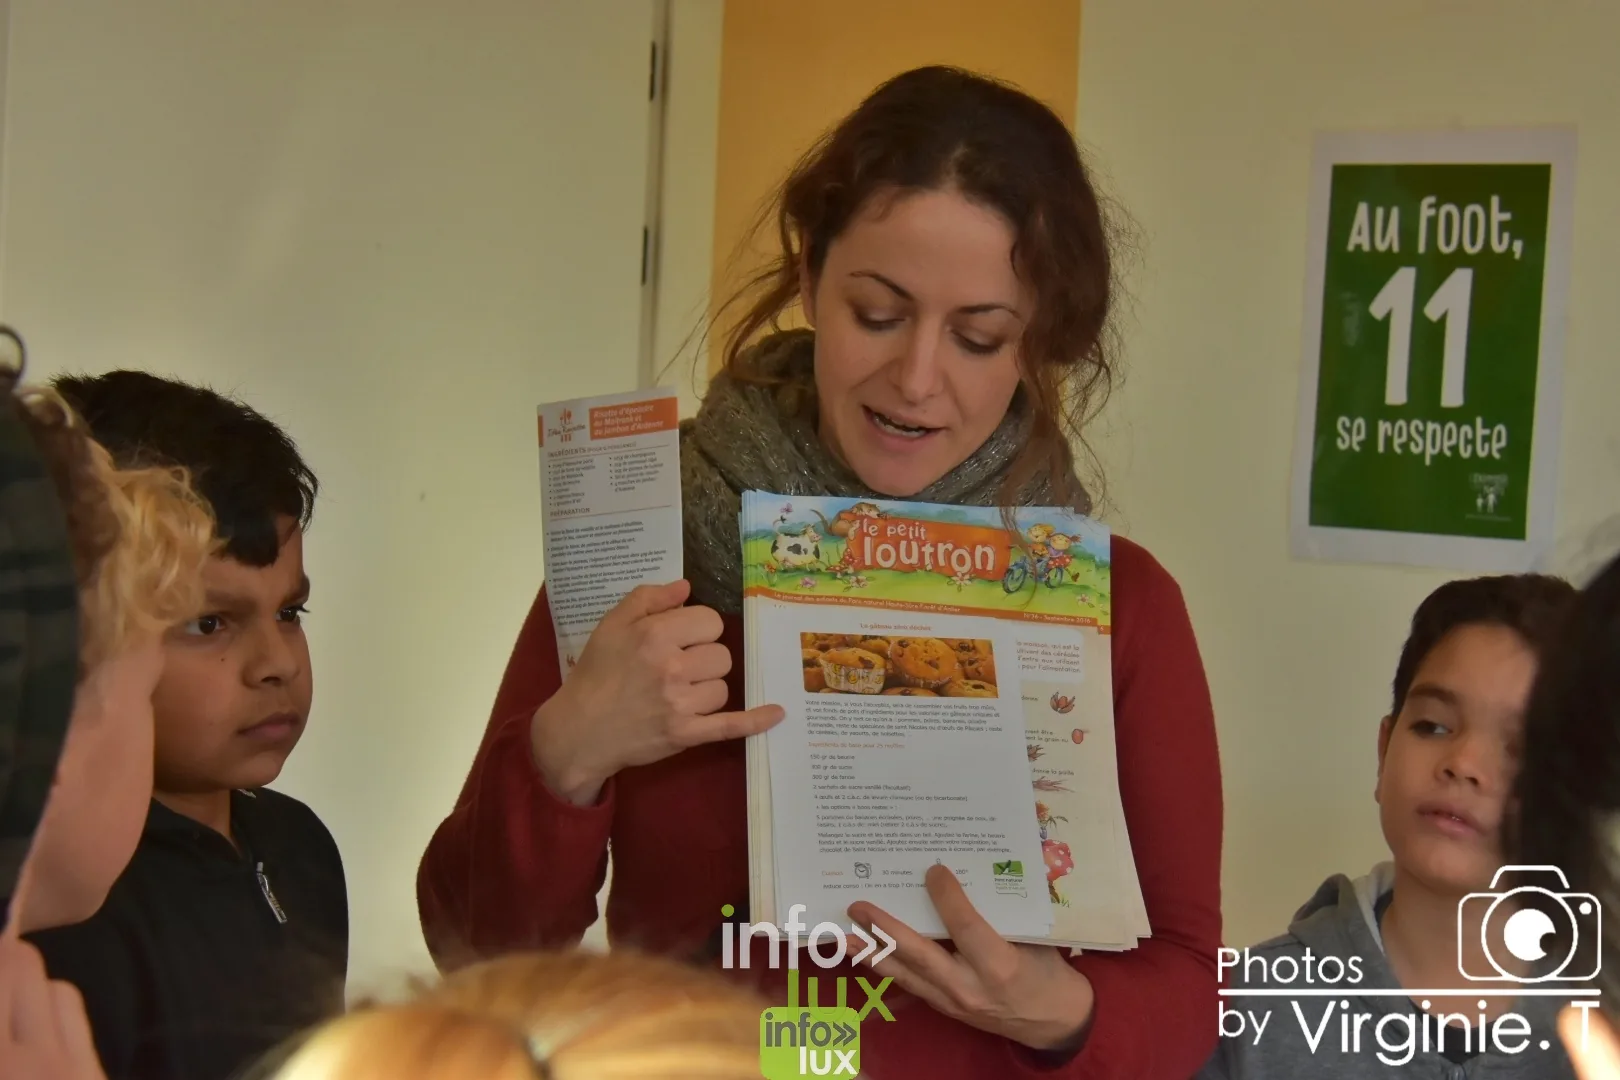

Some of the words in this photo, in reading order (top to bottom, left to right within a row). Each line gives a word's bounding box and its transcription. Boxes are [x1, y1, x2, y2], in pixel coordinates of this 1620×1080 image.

[1417, 195, 1523, 260] foot,
[1369, 266, 1474, 408] 11
[1336, 416, 1366, 453] se
[1377, 416, 1507, 466] respecte
[863, 518, 878, 536] le
[887, 522, 926, 540] petit
[864, 536, 995, 573] loutron
[1044, 614, 1074, 623] Septembre
